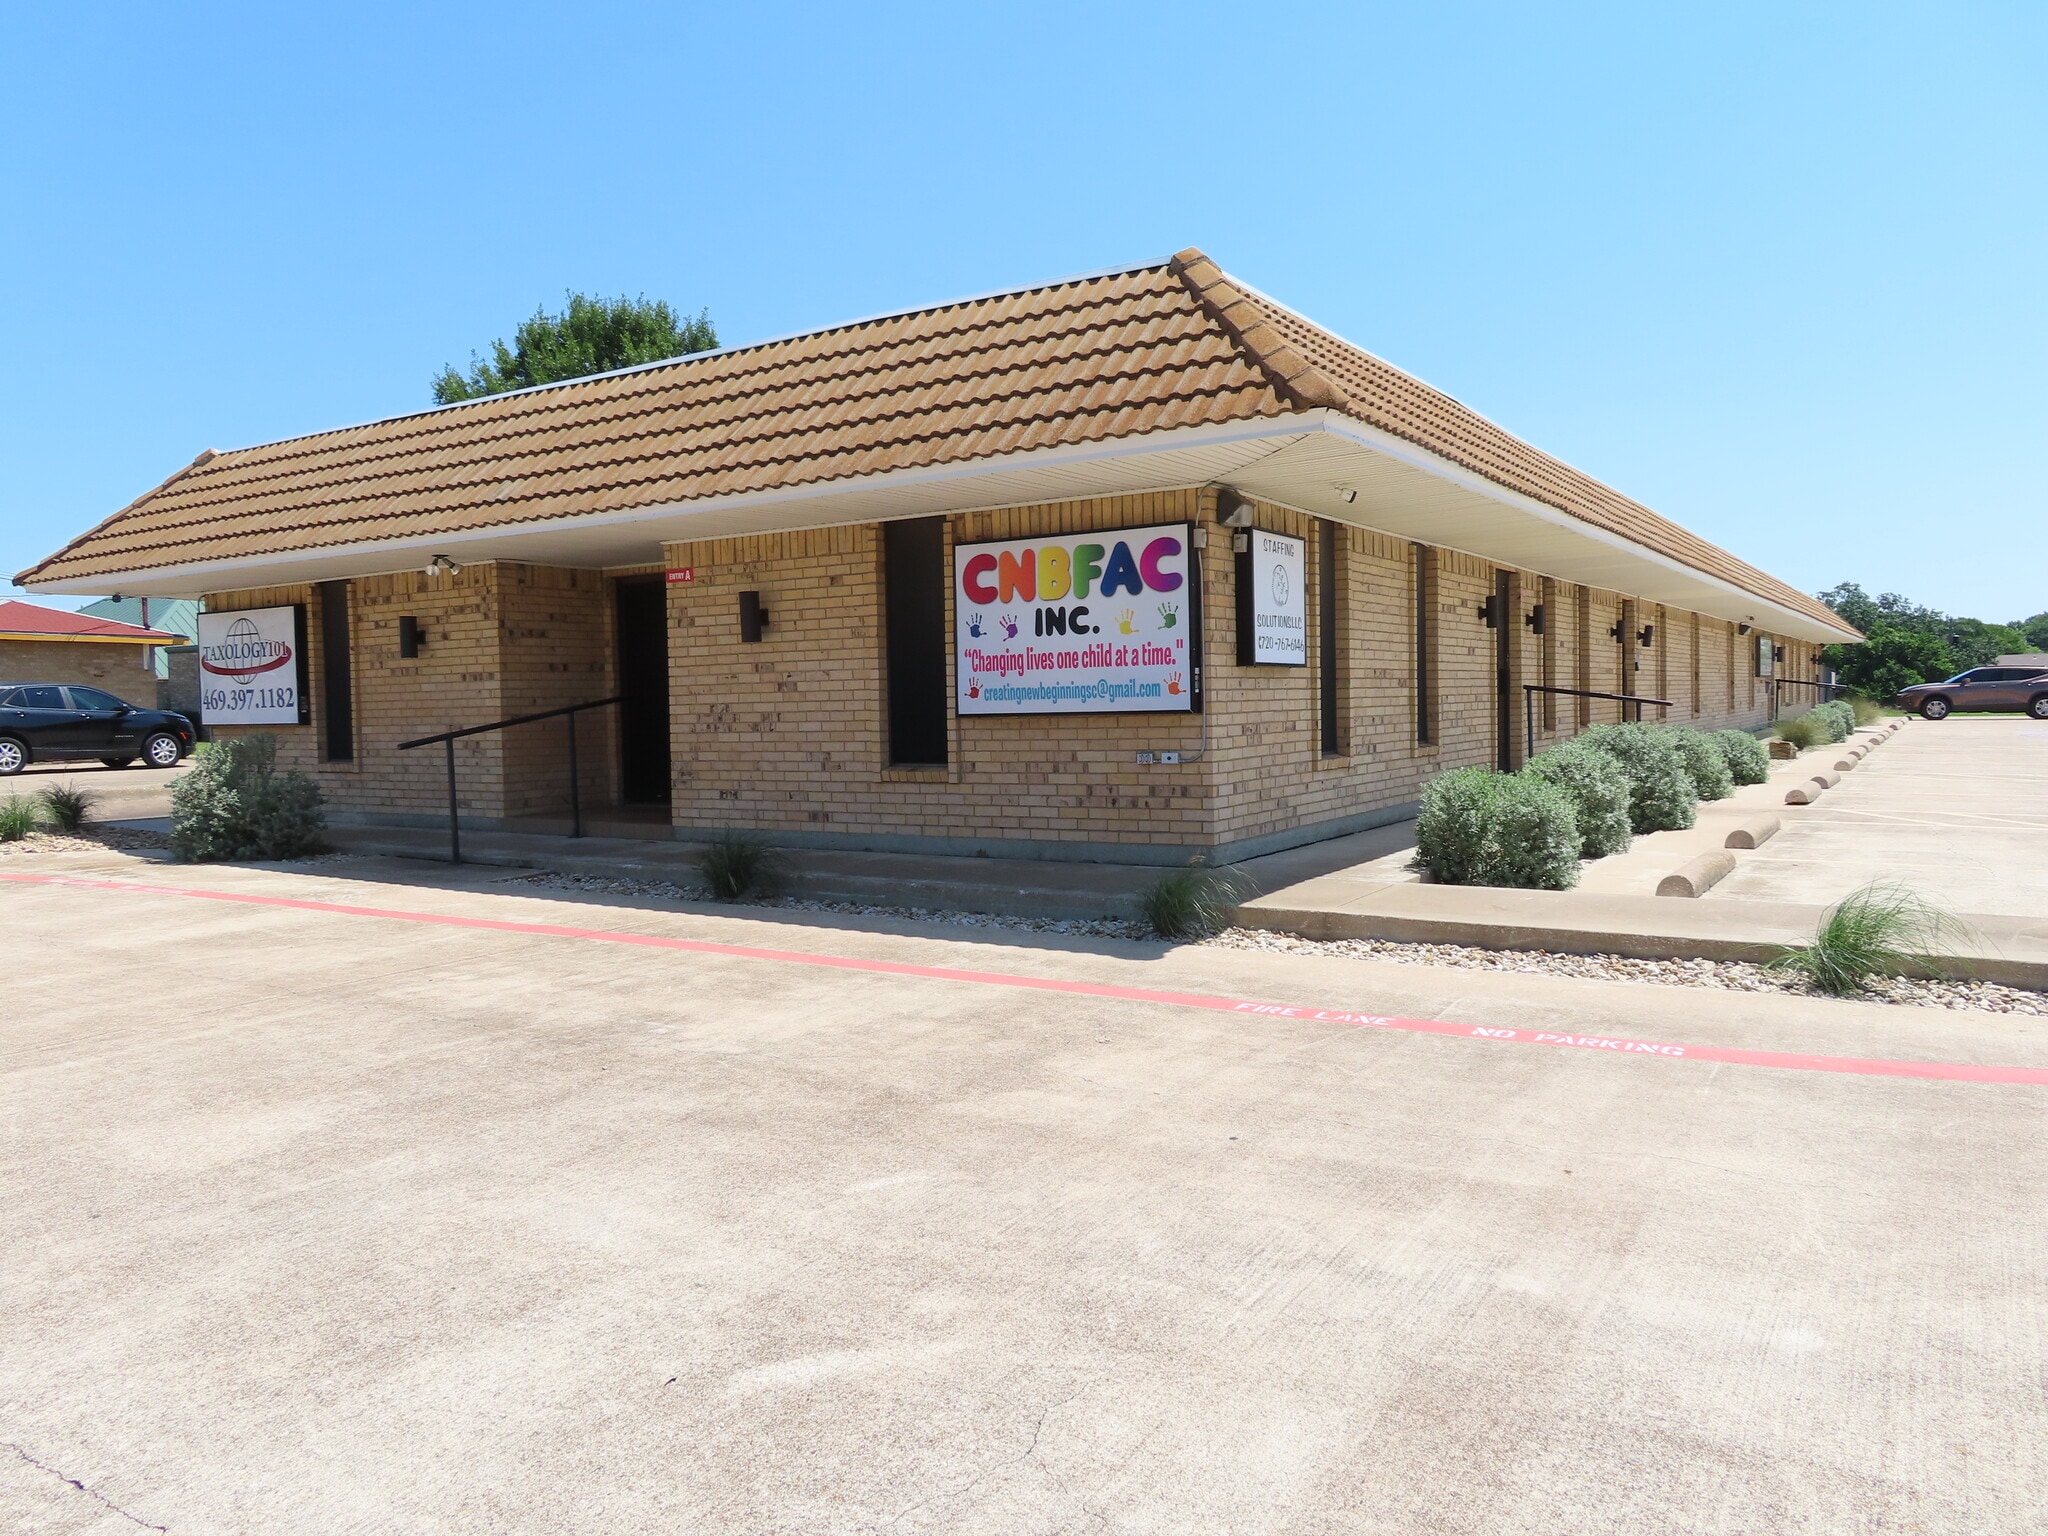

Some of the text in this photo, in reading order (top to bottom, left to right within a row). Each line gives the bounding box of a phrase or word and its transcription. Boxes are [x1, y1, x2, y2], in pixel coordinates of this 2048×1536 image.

[1263, 538, 1295, 558] STAFFING
[669, 570, 691, 581] ENTRY A
[962, 536, 1183, 605] CNBFAC
[1035, 605, 1100, 637] INC.
[202, 641, 288, 662] TAXOLOGY101
[1026, 646, 1054, 670] lives
[1056, 651, 1079, 669] one
[1081, 643, 1112, 668] child
[1115, 646, 1129, 667] at
[1131, 648, 1139, 666] a
[202, 687, 295, 711] 469.397.1182
[983, 678, 1161, 706] creatingnewbeginningsc@gmail.com
[1234, 1002, 1686, 1056] FIRE LANE NO PARKING
